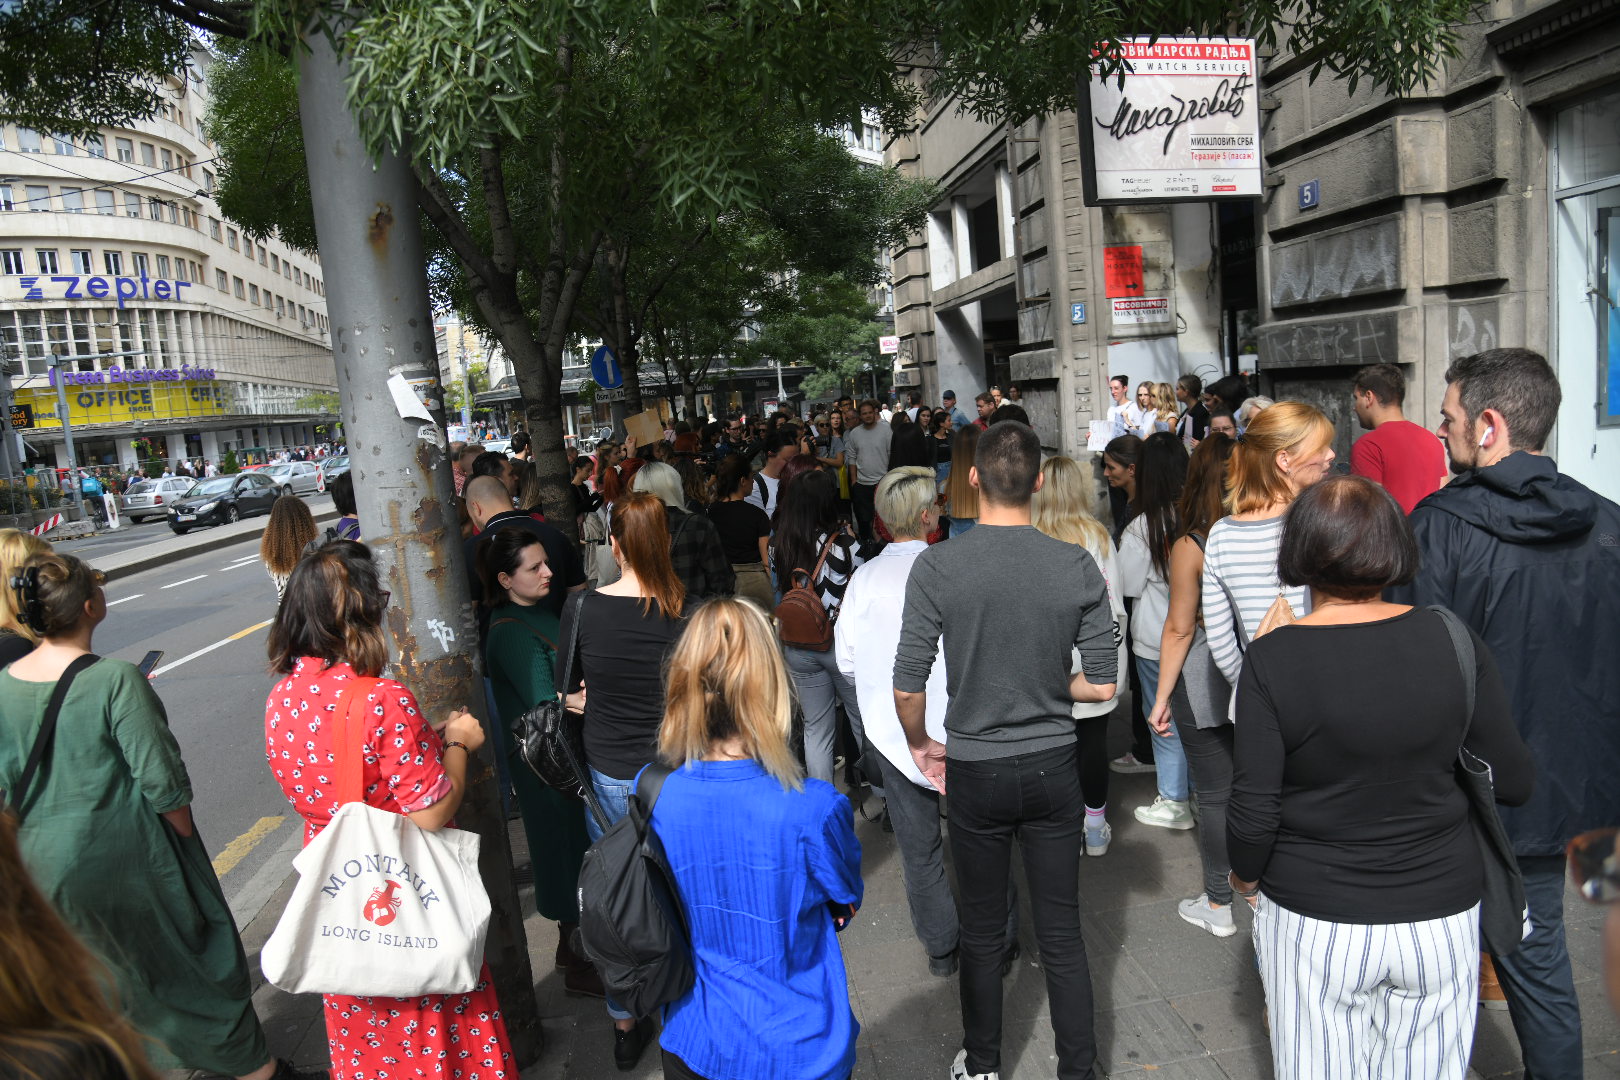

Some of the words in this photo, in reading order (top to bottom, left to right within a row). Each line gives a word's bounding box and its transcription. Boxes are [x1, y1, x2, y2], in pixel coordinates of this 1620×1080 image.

[1205, 46, 1247, 60] РАДЊА
[1147, 62, 1188, 71] WATCH
[1196, 63, 1247, 72] SERVICE
[1190, 136, 1236, 146] МИХАЈЛОВИЋ
[1237, 136, 1254, 146] СРБА
[1190, 151, 1221, 162] Теразије
[1228, 151, 1255, 161] (пасаж)
[1303, 185, 1311, 204] 5
[51, 269, 192, 309] zepter
[1114, 299, 1168, 310] часовничар
[1073, 305, 1082, 321] 5
[77, 388, 151, 409] OFFICE
[320, 854, 440, 910] MONTAUK
[322, 925, 371, 942] LONG
[378, 932, 438, 949] ISLAND
